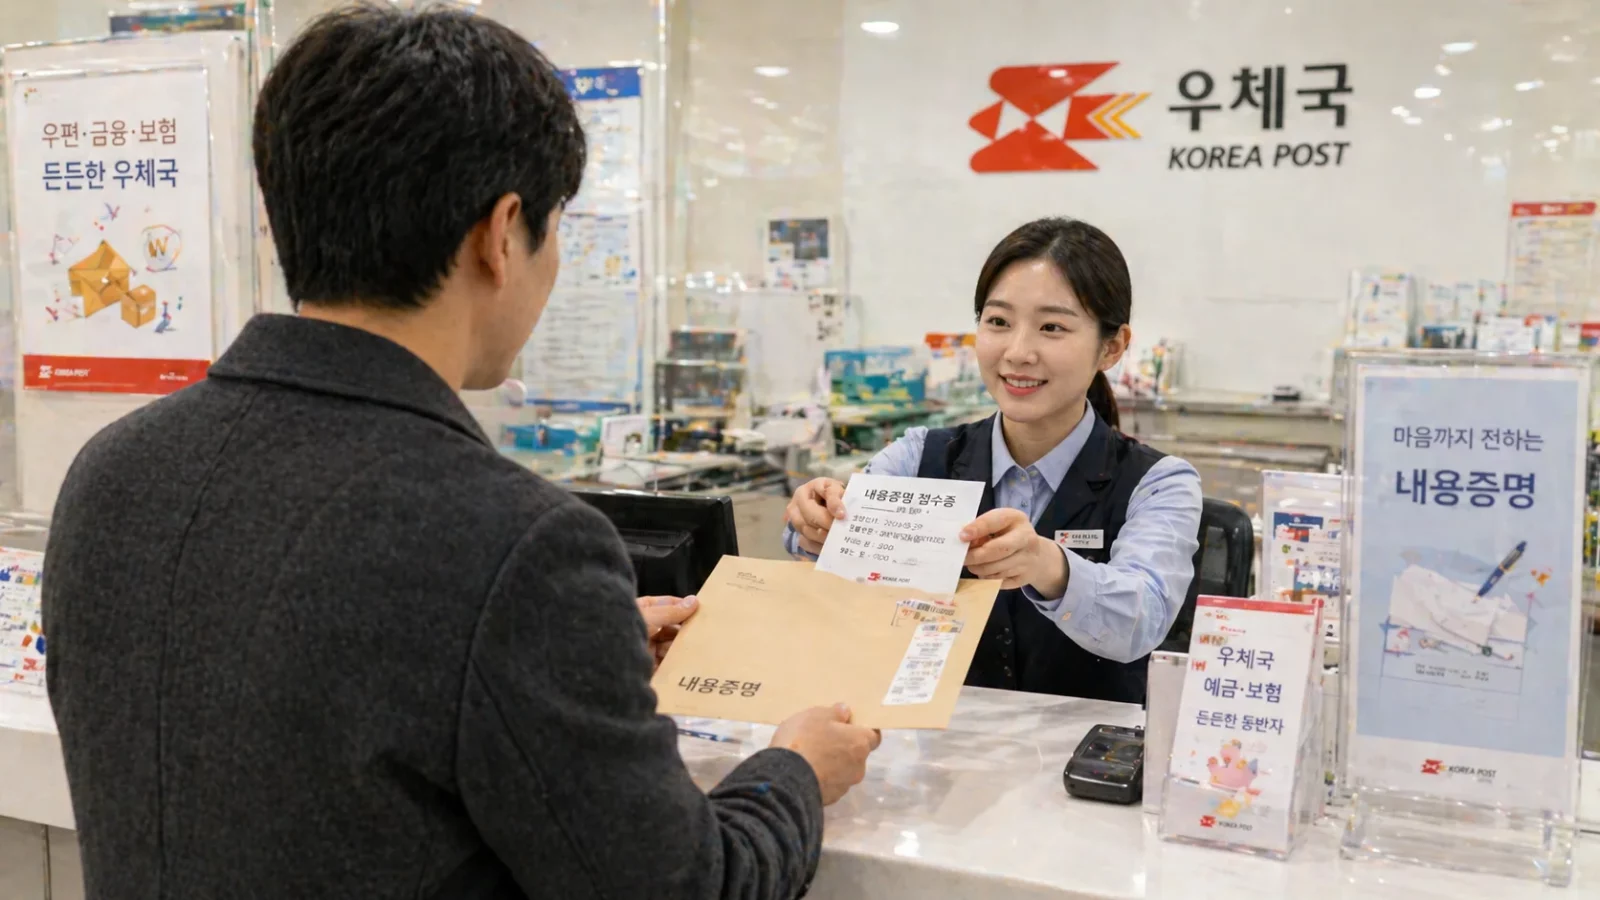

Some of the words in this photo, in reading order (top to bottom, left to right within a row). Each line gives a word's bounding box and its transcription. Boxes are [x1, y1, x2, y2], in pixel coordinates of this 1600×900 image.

[1168, 63, 1353, 132] 우체국
[41, 118, 178, 149] 우편·금융·보험
[1168, 146, 1262, 170] KOREA
[1273, 142, 1350, 167] POST
[42, 160, 106, 191] 든든한
[112, 158, 178, 190] 우체국
[1393, 426, 1474, 451] 마음까지
[1480, 429, 1544, 453] 전하는
[1395, 469, 1536, 510] 내용증명
[1217, 646, 1275, 671] 우체국
[678, 675, 761, 698] 내용증명
[1203, 677, 1283, 703] 예금·보험
[1196, 710, 1238, 729] 든든한
[1242, 714, 1285, 735] 동반자
[1448, 765, 1475, 775] KOREA
[1477, 769, 1497, 778] POST
